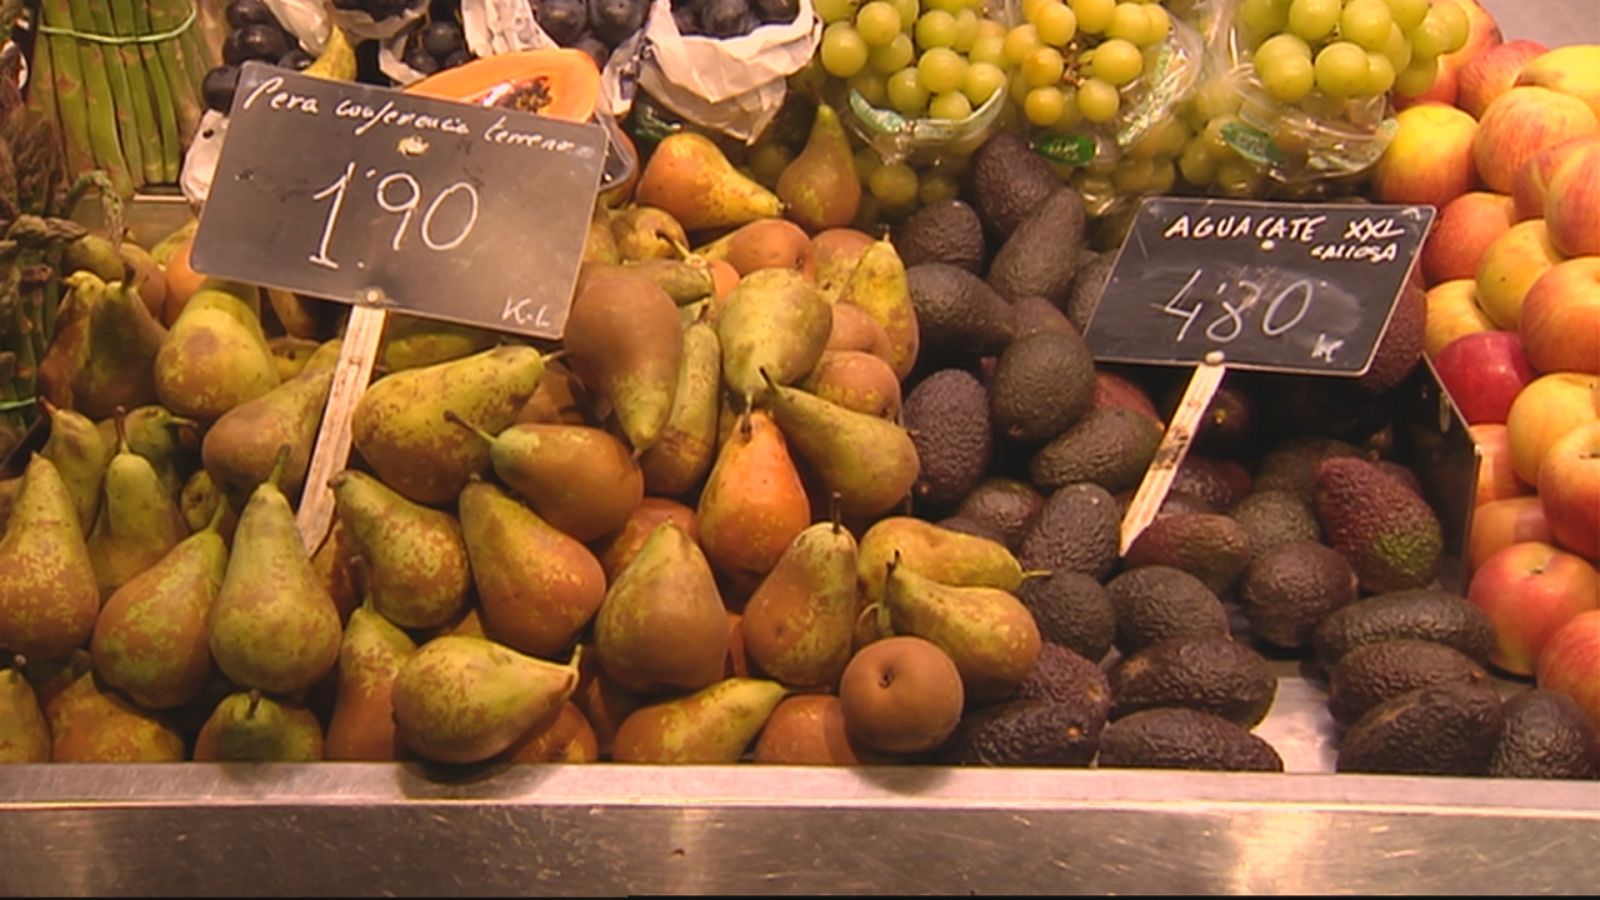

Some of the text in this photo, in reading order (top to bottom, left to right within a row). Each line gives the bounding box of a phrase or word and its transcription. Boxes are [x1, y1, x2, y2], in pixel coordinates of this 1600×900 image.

[243, 76, 319, 113] Pera
[1164, 215, 1405, 243] AGUACATE XXL
